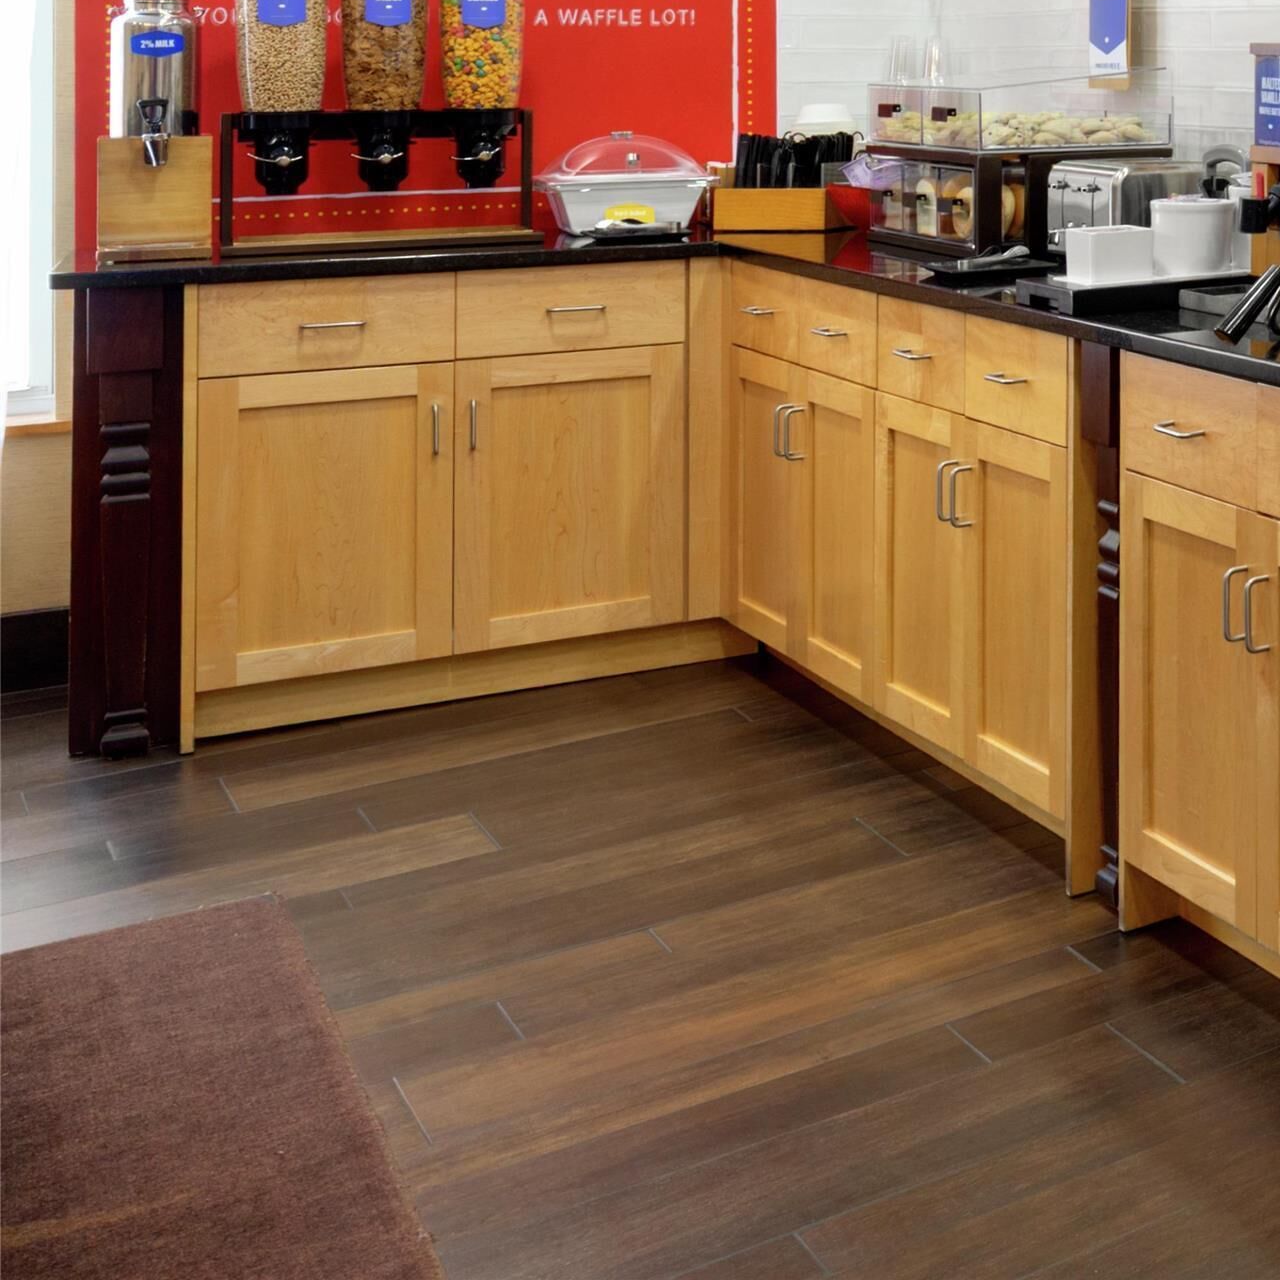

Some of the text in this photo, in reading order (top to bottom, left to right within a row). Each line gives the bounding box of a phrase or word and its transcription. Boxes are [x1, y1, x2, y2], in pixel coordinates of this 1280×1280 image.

[534, 9, 548, 26] A
[558, 9, 641, 27] WAFFLE
[650, 9, 696, 27] LOT!
[140, 39, 175, 49] 2% MILK
